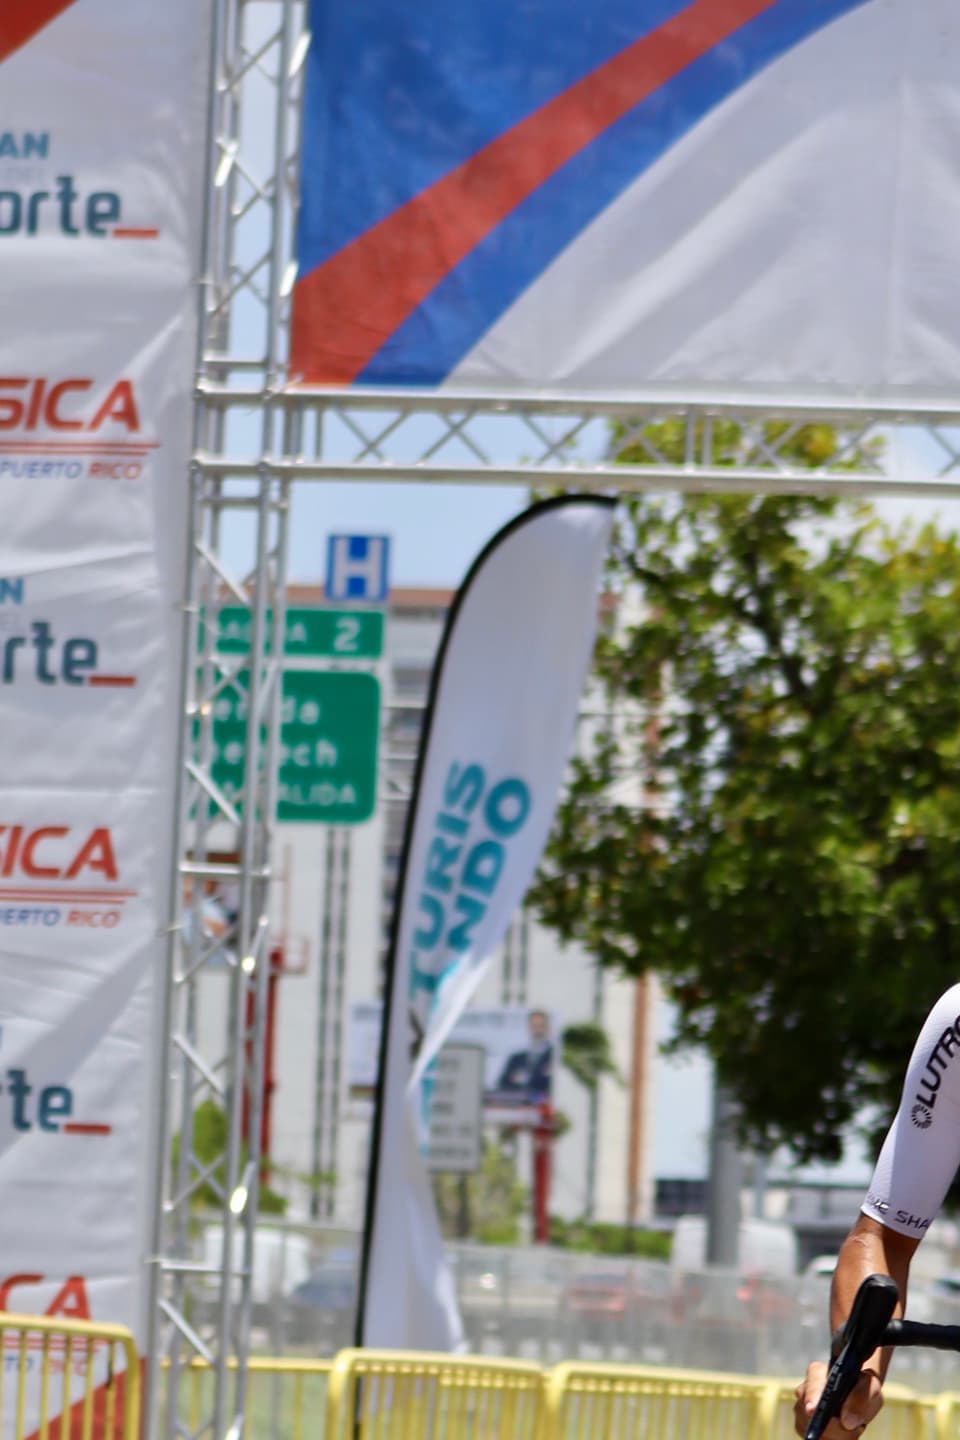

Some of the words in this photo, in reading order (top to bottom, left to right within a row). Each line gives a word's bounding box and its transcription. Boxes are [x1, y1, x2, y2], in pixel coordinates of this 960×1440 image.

[88, 462, 142, 480] RICO
[333, 616, 361, 652] 2
[0, 824, 119, 881] ICA
[0, 908, 61, 926] ERTO
[66, 909, 121, 929] RICO
